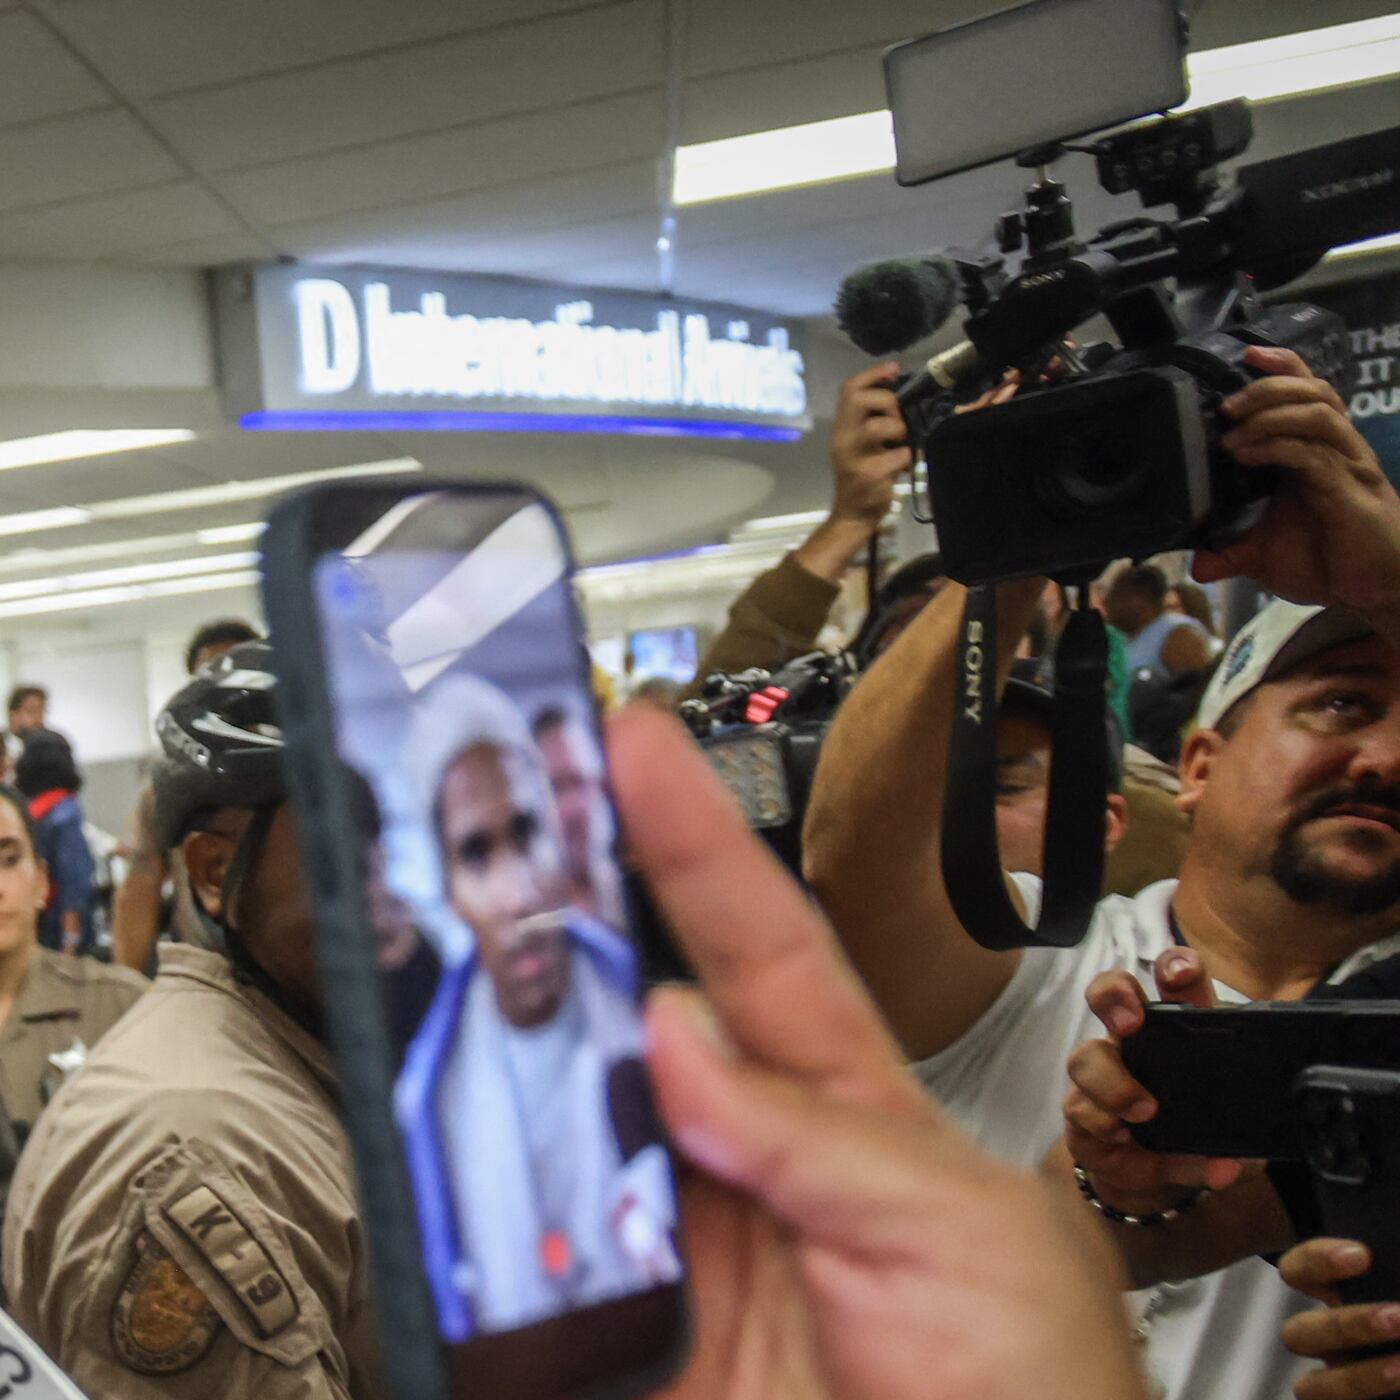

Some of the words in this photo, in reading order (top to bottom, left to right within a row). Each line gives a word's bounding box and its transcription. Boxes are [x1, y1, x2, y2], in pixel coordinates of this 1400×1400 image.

[293, 278, 361, 394] D
[1356, 356, 1396, 386] IT
[965, 620, 984, 725] SONY
[189, 1203, 283, 1307] K-9
